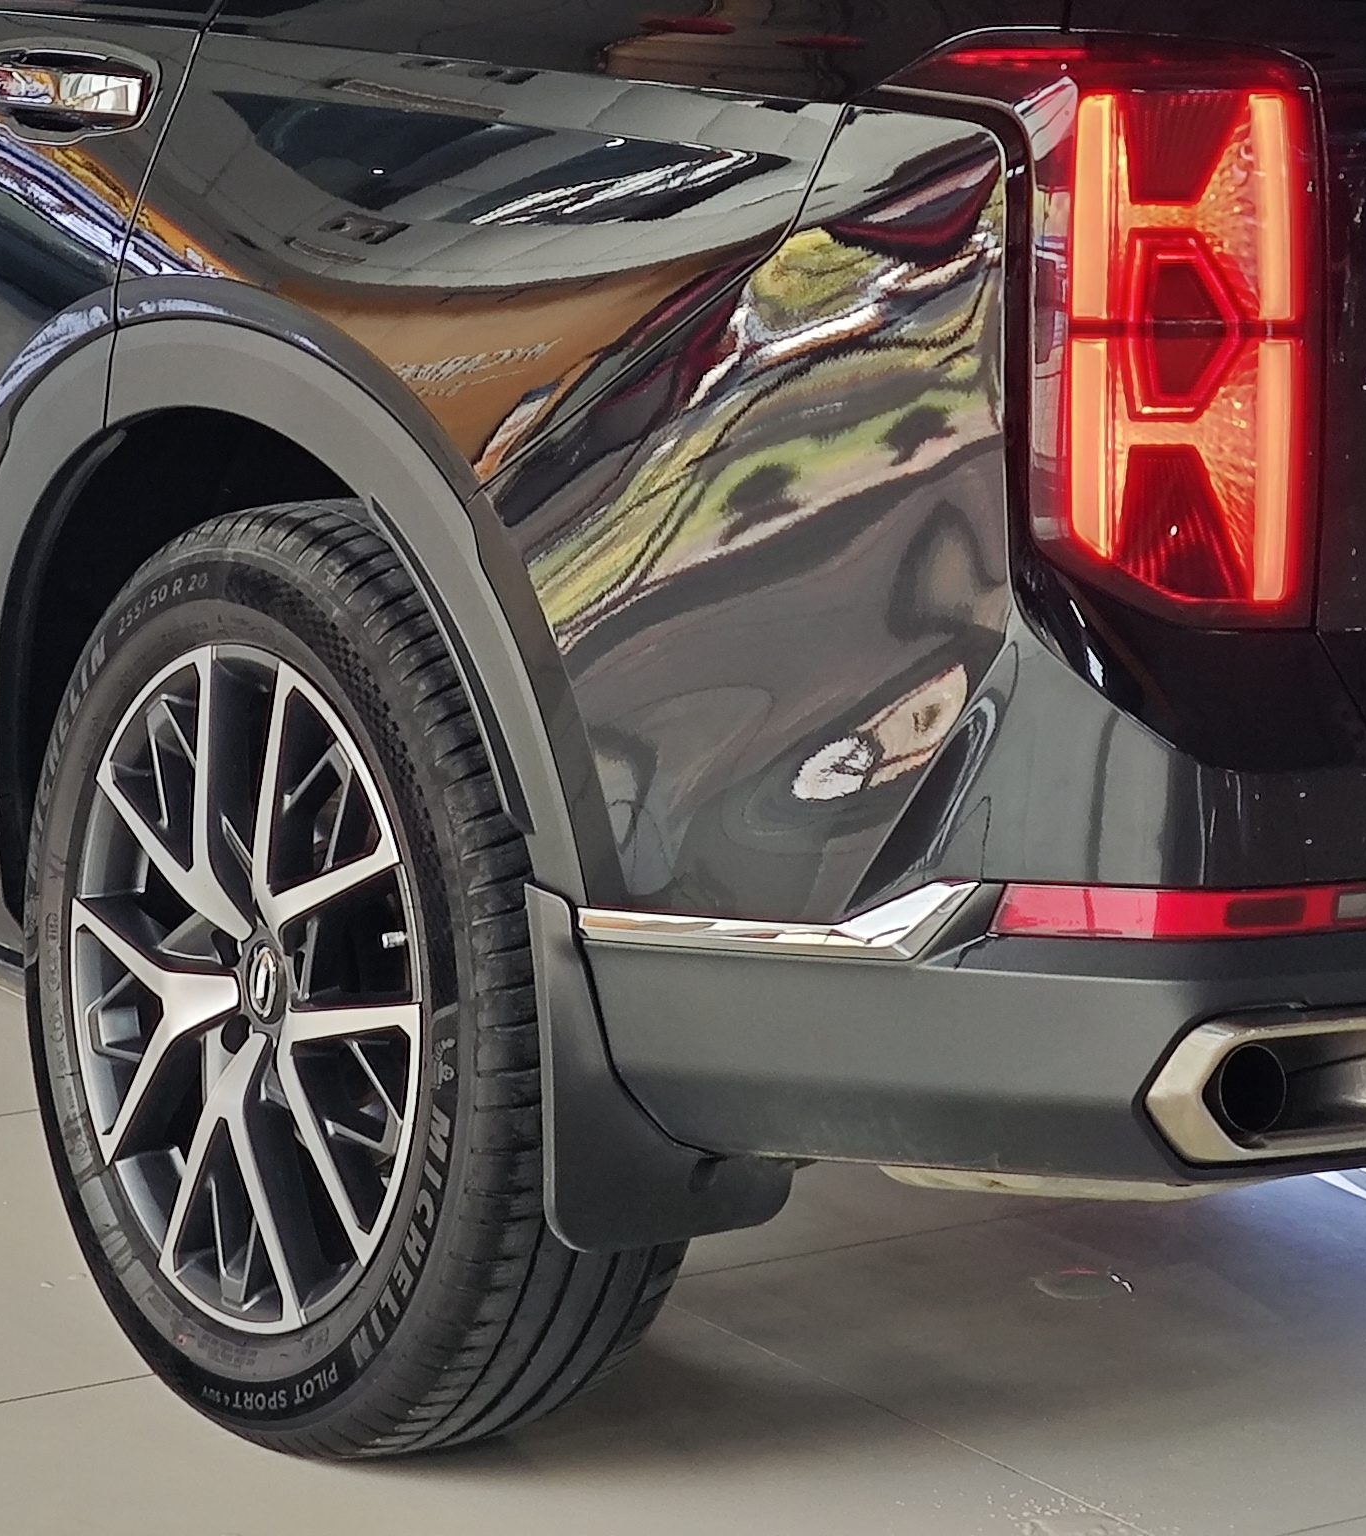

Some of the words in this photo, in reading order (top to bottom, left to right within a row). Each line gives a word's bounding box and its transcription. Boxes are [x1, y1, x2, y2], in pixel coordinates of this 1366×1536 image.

[350, 1104, 451, 1368] MICHELIN
[233, 1389, 287, 1410] SPORT
[293, 1362, 340, 1404] PILOT
